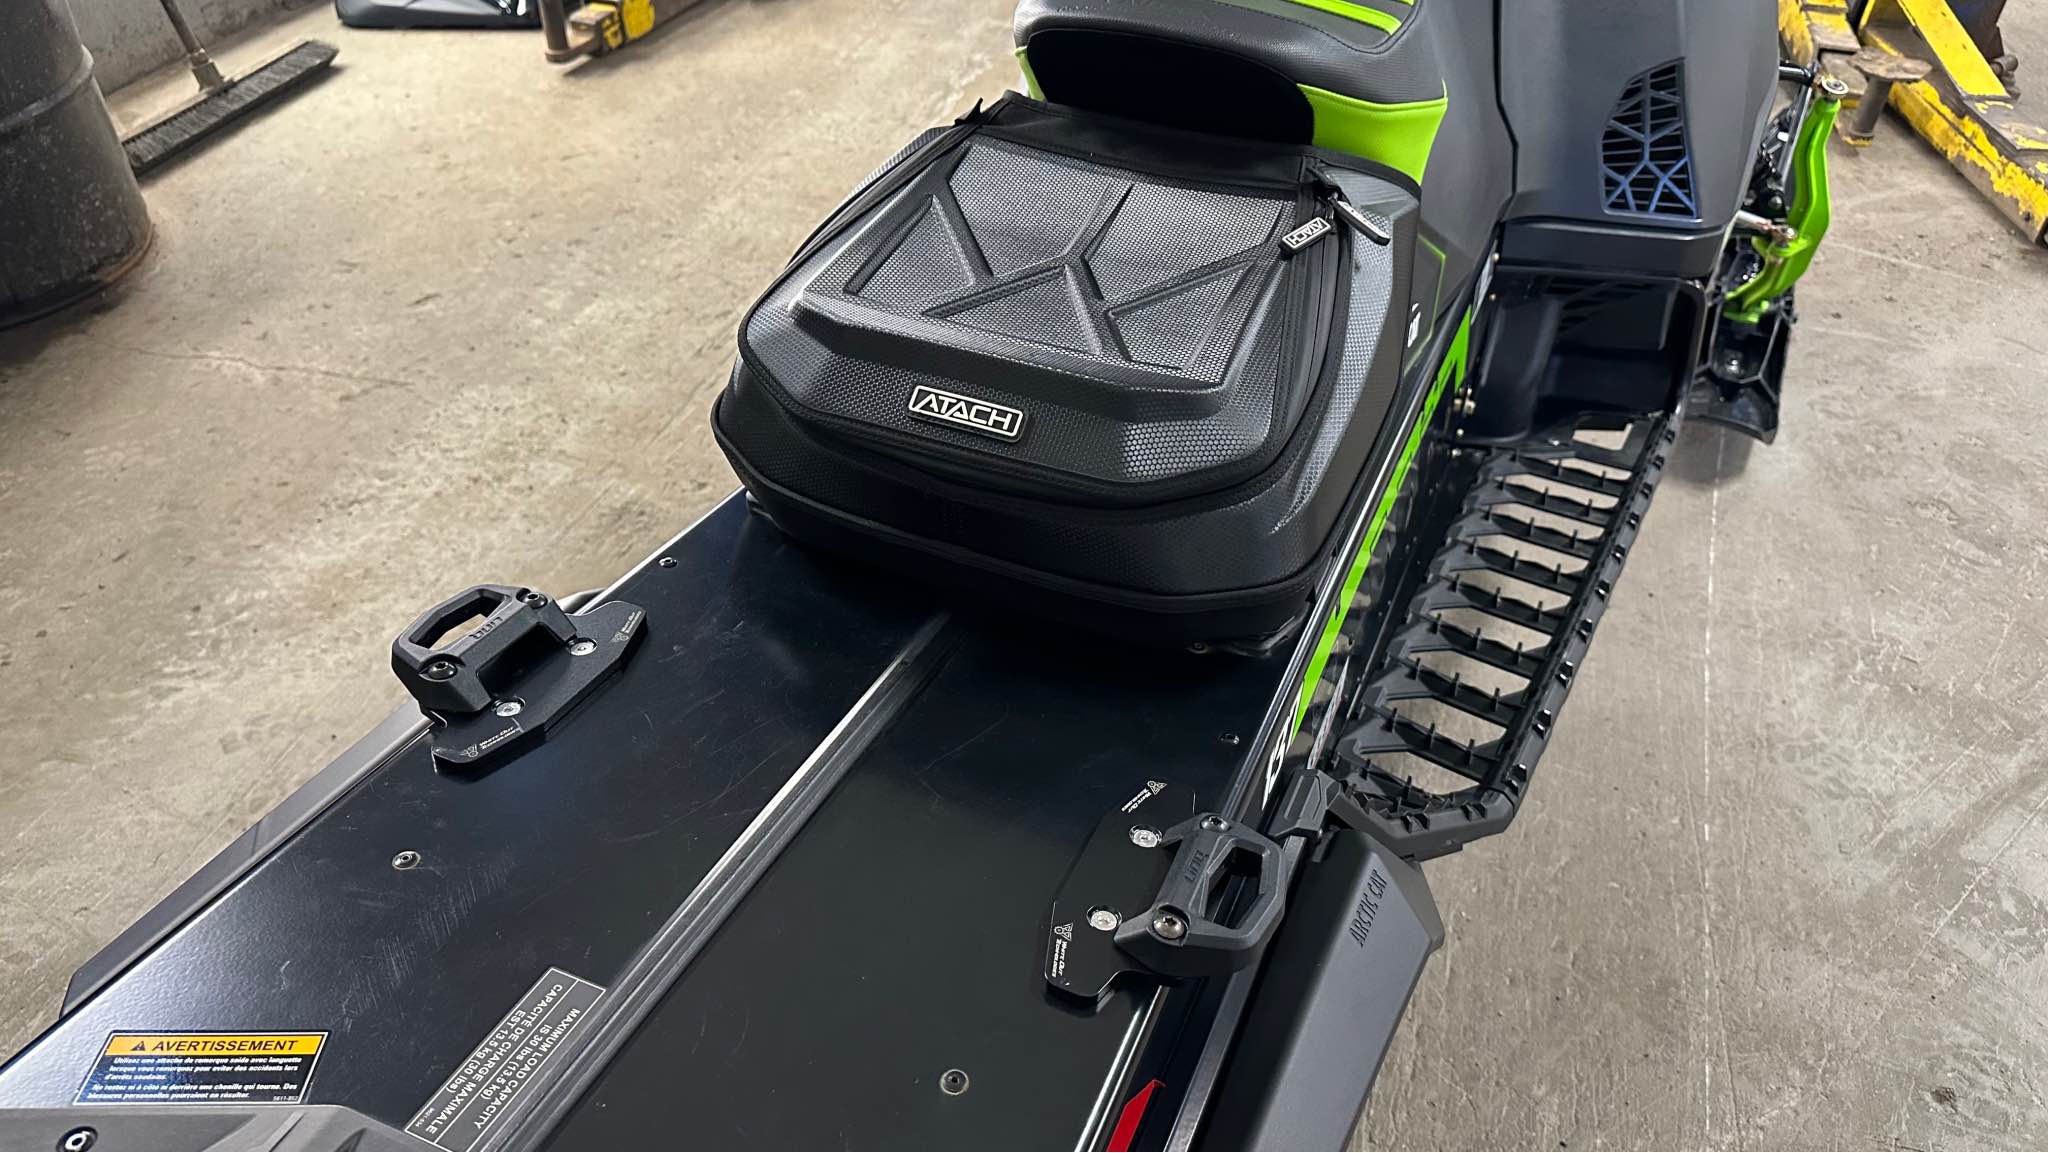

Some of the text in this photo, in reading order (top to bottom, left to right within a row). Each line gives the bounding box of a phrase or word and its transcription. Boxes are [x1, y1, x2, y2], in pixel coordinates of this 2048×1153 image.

[1287, 219, 1324, 246] ATACH
[914, 393, 1012, 430] ATACH
[1349, 868, 1388, 949] ARCTIC CAT
[521, 984, 563, 1029] CAPACITÉ
[152, 1040, 298, 1051] AVERTISSEMENT
[445, 1009, 527, 1093] EST 13.5 kg (30 lbs)
[508, 1027, 525, 1042] DE
[194, 1057, 229, 1065] remorque
[248, 1064, 284, 1072] accidents
[473, 1042, 512, 1082] CHARGE
[474, 1008, 581, 1130] MAXIMUM LOAD CAPACITY
[480, 1024, 553, 1101] IS 30 lbs (13.5 kg)
[282, 1082, 297, 1090] Des
[426, 1081, 477, 1135] MAXIMALE
